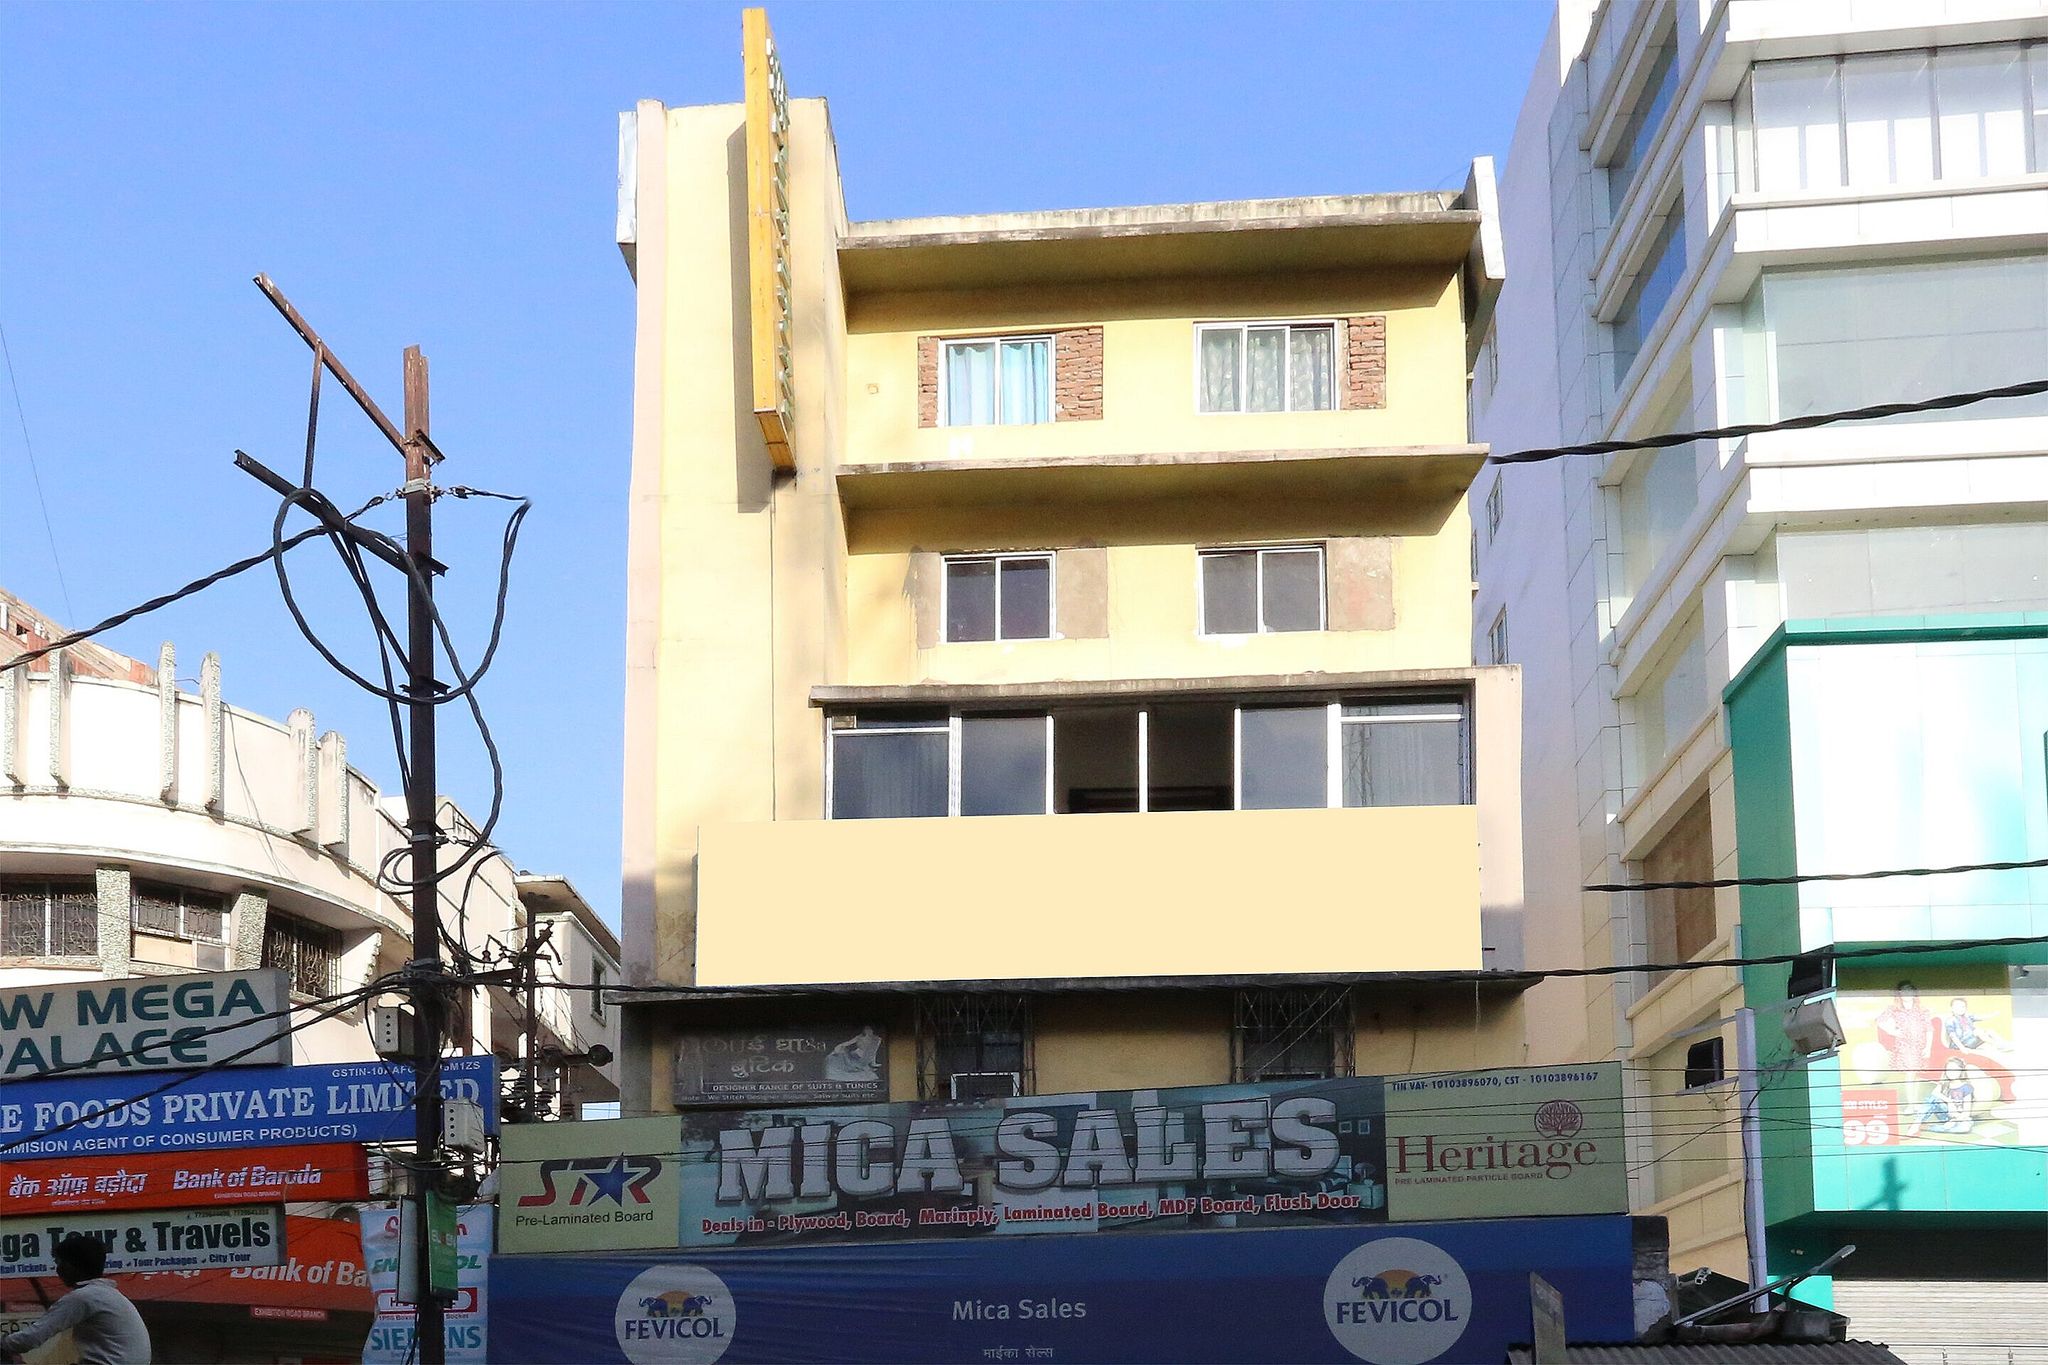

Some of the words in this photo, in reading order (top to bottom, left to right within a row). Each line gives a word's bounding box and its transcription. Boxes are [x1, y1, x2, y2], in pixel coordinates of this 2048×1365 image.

[77, 978, 266, 1026] MEGA
[0, 1026, 208, 1075] ALACE
[712, 1083, 757, 1092] DESIGNER
[758, 1082, 789, 1091] RANGE
[791, 1082, 803, 1091] OF
[806, 1082, 833, 1091] SUITS
[845, 1082, 878, 1090] TUNICS
[1431, 1077, 1501, 1090] 10103896070,
[1504, 1075, 1520, 1086] CST
[1531, 1071, 1598, 1084] 10103896167
[1, 1104, 23, 1133] E
[34, 1096, 150, 1131] FOODS
[163, 1086, 315, 1124] PRIVATE
[72, 1137, 129, 1151] AGENT
[133, 1135, 156, 1147] OF
[160, 1129, 254, 1146] CONSUMER
[260, 1123, 357, 1140] PRODUCTS)
[1842, 1119, 1890, 1146] 99
[717, 1115, 967, 1202] MICA
[997, 1095, 1342, 1190] SALES
[1395, 1134, 1598, 1180] Heritage
[9, 1174, 41, 1198] बैंक
[173, 1168, 225, 1190] Bank
[227, 1166, 249, 1187] of
[250, 1163, 322, 1187] Baroda
[517, 1152, 662, 1208] STAR
[1395, 1177, 1412, 1185] PRE
[1415, 1176, 1464, 1185] LAMINATED
[1466, 1174, 1509, 1182] PARTICLE
[1511, 1173, 1543, 1181] BOARD
[516, 1212, 610, 1226] Pre-Laminated
[614, 1210, 654, 1223] Board
[701, 1217, 745, 1234] Deals
[747, 1217, 765, 1232] in
[777, 1212, 852, 1233] Plywood,
[856, 1209, 911, 1228] Board,
[918, 1206, 999, 1225] Marinply,
[1004, 1205, 1092, 1222] Laminated
[1097, 1202, 1154, 1218] Board,
[1159, 1198, 1197, 1216] MDF
[1201, 1196, 1261, 1215] Board,
[1264, 1193, 1312, 1212] Flush
[1317, 1193, 1361, 1209] Door
[0, 1232, 40, 1262] ga
[46, 1227, 118, 1257] Tr
[124, 1227, 148, 1251] &
[153, 1217, 272, 1251] Travels
[17, 1263, 48, 1273] Tickets
[133, 1257, 152, 1268] Tour
[155, 1255, 198, 1267] Packages
[208, 1253, 228, 1264] City
[230, 1252, 251, 1263] Tour
[306, 1259, 333, 1285] of
[952, 1299, 1011, 1321] Mica
[1018, 1297, 1087, 1319] Sales
[1336, 1299, 1459, 1324] FEVICOL
[371, 1325, 481, 1350] SIENS
[625, 1317, 725, 1340] FEVICOL
[983, 1344, 1020, 1361] माईका
[1025, 1344, 1054, 1358] सेल्स
